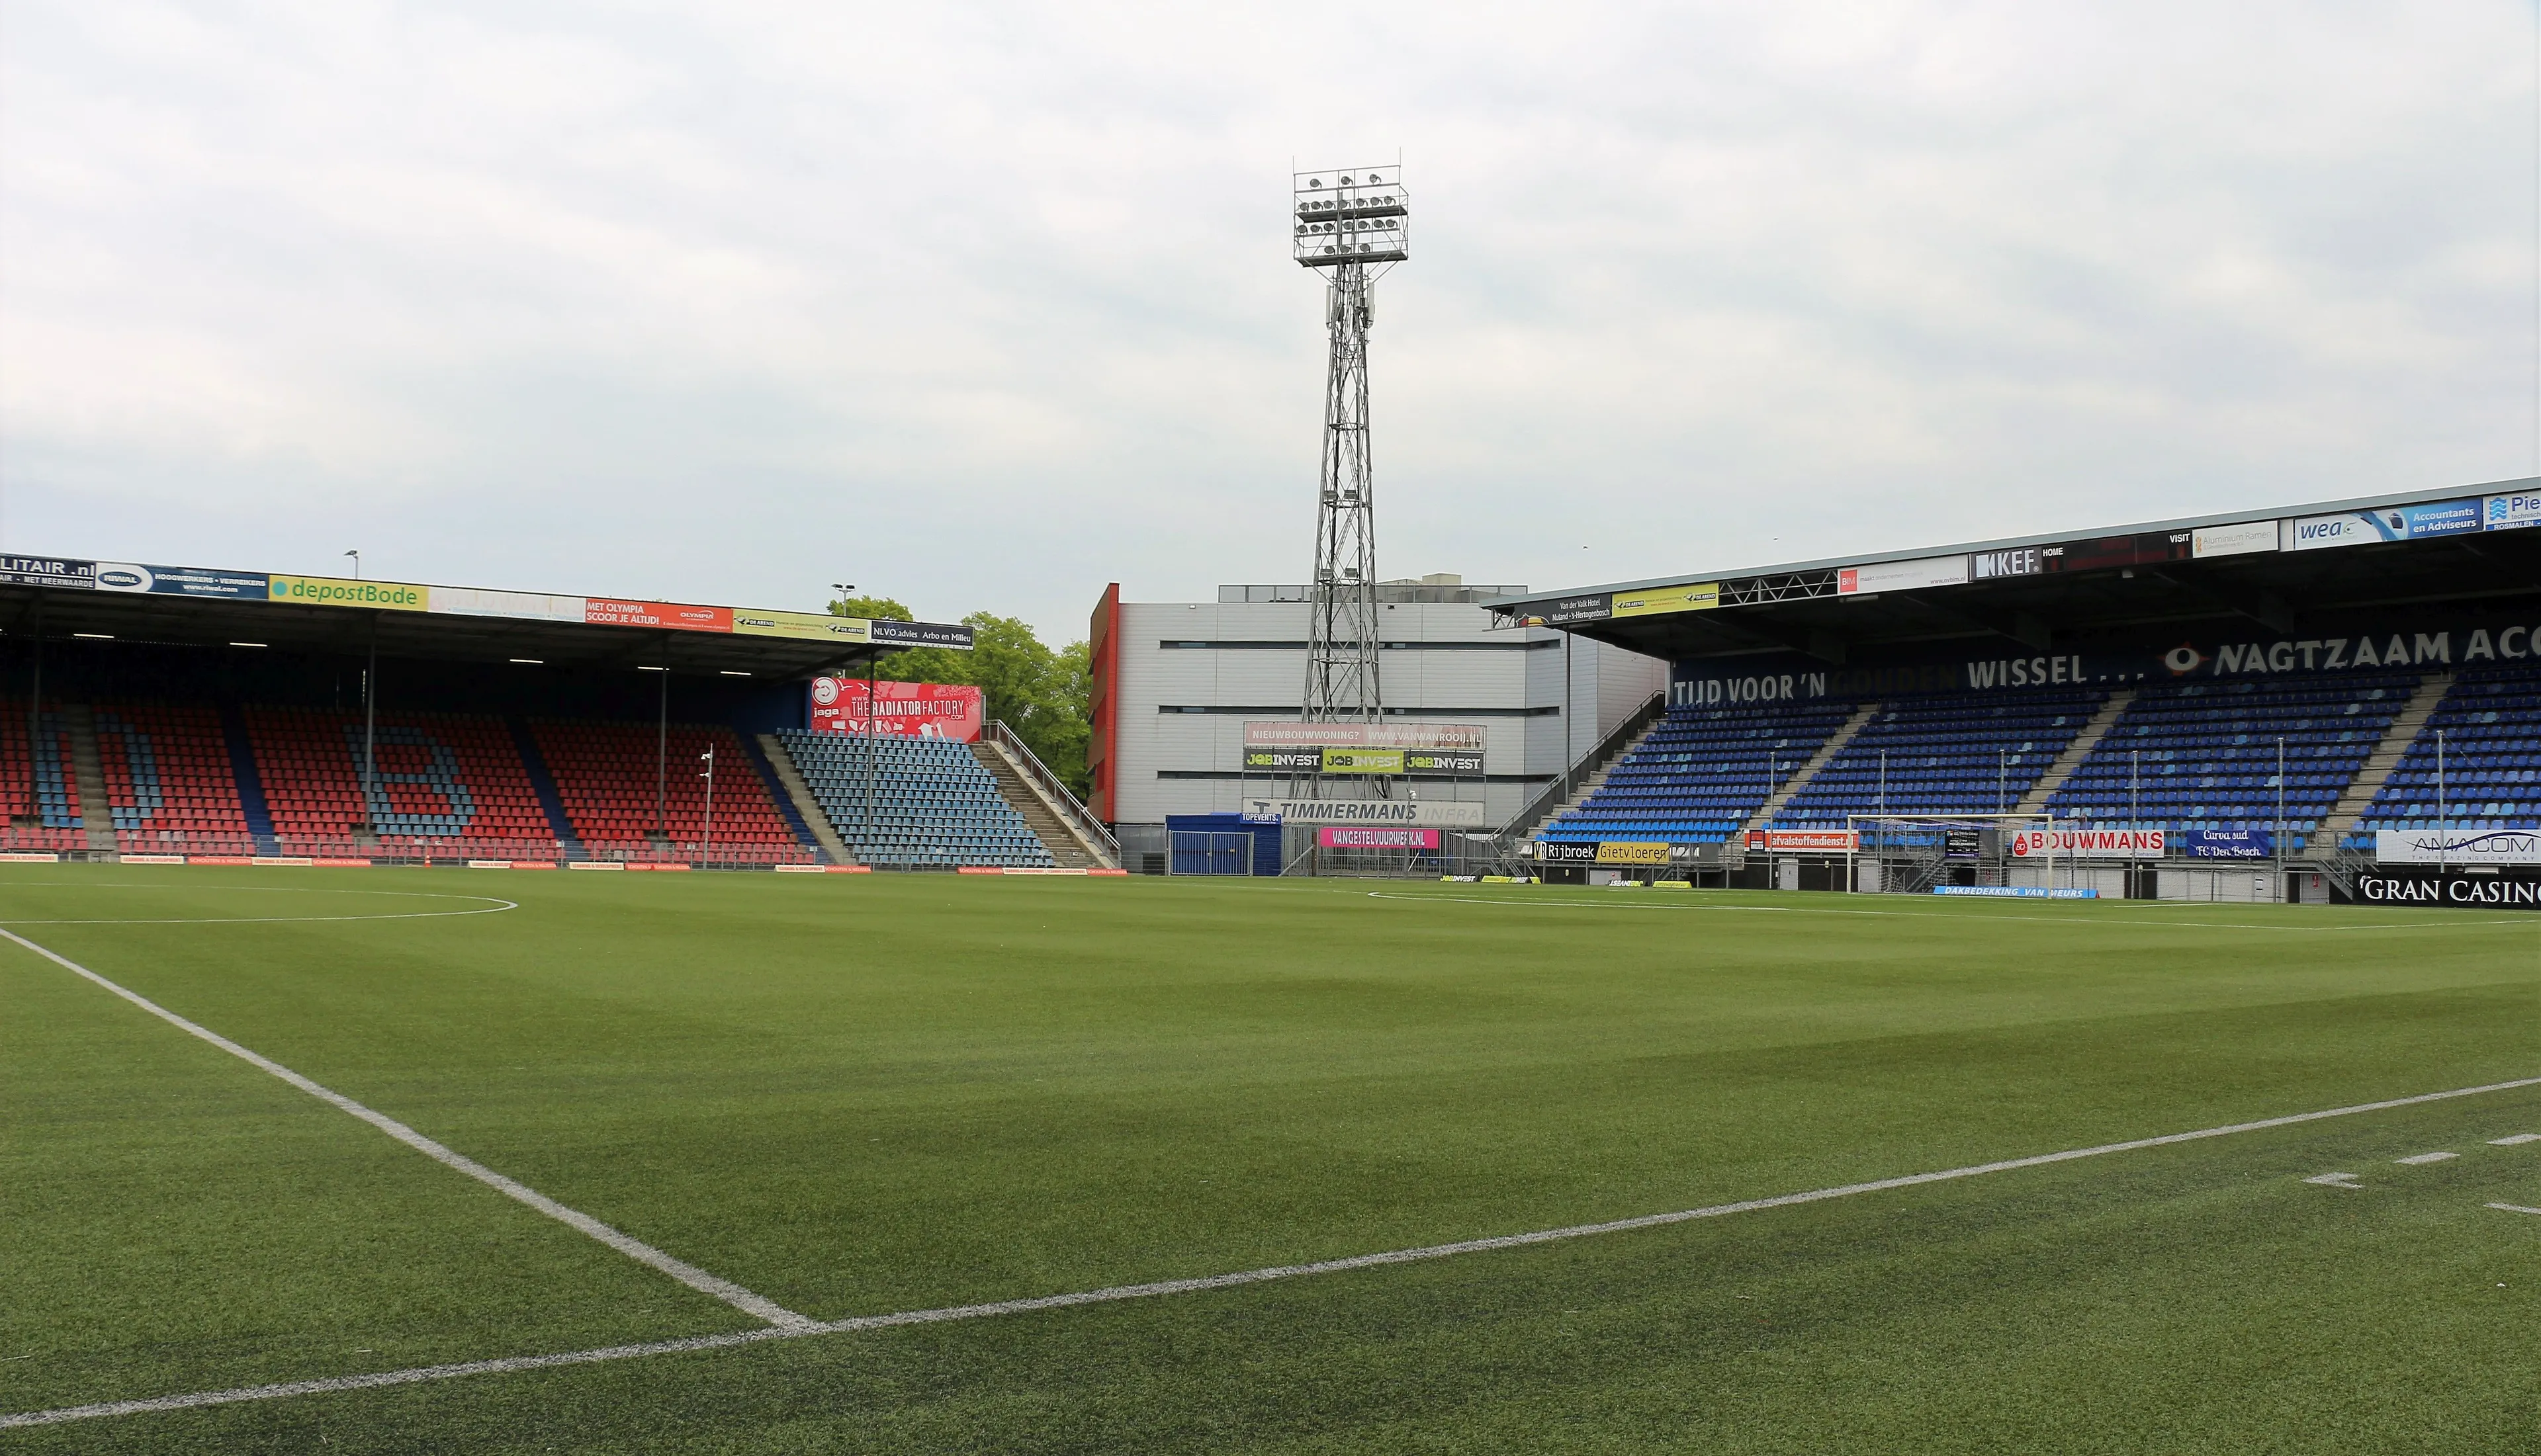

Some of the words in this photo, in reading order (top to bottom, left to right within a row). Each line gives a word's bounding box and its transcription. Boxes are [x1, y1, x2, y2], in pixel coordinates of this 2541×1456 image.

[2511, 495, 2541, 511] Pie
[2413, 507, 2475, 521] Accountants
[2301, 521, 2342, 539] wea
[2413, 524, 2425, 533] en
[2427, 518, 2477, 531] Adviseurs
[2494, 521, 2534, 530] ROSMALEN
[2169, 533, 2190, 543] VISIT
[2203, 535, 2243, 544] Aluminium
[2245, 531, 2272, 540] Ramen
[2042, 547, 2063, 557] HOME
[1997, 550, 2035, 576] KEF
[42, 577, 94, 588] MEERWAARDE
[103, 574, 138, 584] RIWAL
[155, 573, 214, 583] HOOGWERKERS
[219, 578, 266, 587] VERREIKERS
[1842, 577, 1855, 585] BIM
[1930, 576, 1966, 585] www.nvbim.nl
[183, 584, 238, 593] www.riwal.com
[292, 579, 417, 605] depostBode
[587, 602, 605, 612] MET
[606, 603, 645, 614] OLYMPIA
[1587, 598, 1601, 607] Hotel
[587, 612, 618, 622] SCOOR
[619, 615, 629, 623] JE
[631, 615, 660, 625] ALTIJD!
[1552, 613, 1568, 621] Nuland
[873, 627, 896, 636] NLVO
[952, 633, 971, 642] Milieu
[2213, 631, 2452, 676] NAGTZAAM
[1674, 677, 1720, 707] TIJD
[1727, 673, 1793, 701] VOOR
[1799, 671, 1826, 699] 'N
[1967, 656, 2088, 689] WISSEL
[813, 707, 839, 718] jaga
[1253, 730, 1359, 740] NIEUWBOUWWONING?
[1368, 731, 1482, 744] WWW.VANWANROOIJ.NL
[1247, 753, 1319, 766] JOBINVEST
[1326, 755, 1401, 767] JOBINVEST
[1405, 756, 1481, 769] JOBINVEST
[1280, 803, 1417, 820] TIMMERMANS
[1424, 807, 1480, 821] INFRA
[1332, 830, 1425, 845] VANGESTELVUURWERK.NL
[2031, 832, 2163, 849] BOUWMANS
[2204, 830, 2231, 839] Curva
[2232, 830, 2249, 839] sud
[2196, 845, 2209, 856] FC
[2211, 846, 2231, 856] Den
[2231, 845, 2261, 856] Bosch
[2413, 837, 2534, 852] AMACOM
[1548, 844, 1595, 860] Rijbroek
[1600, 845, 1667, 859] Gietvloeren
[1945, 887, 2018, 896] DAKBEDEKKING
[2364, 879, 2441, 901] GRAN
[2450, 880, 2541, 904] CASIN
